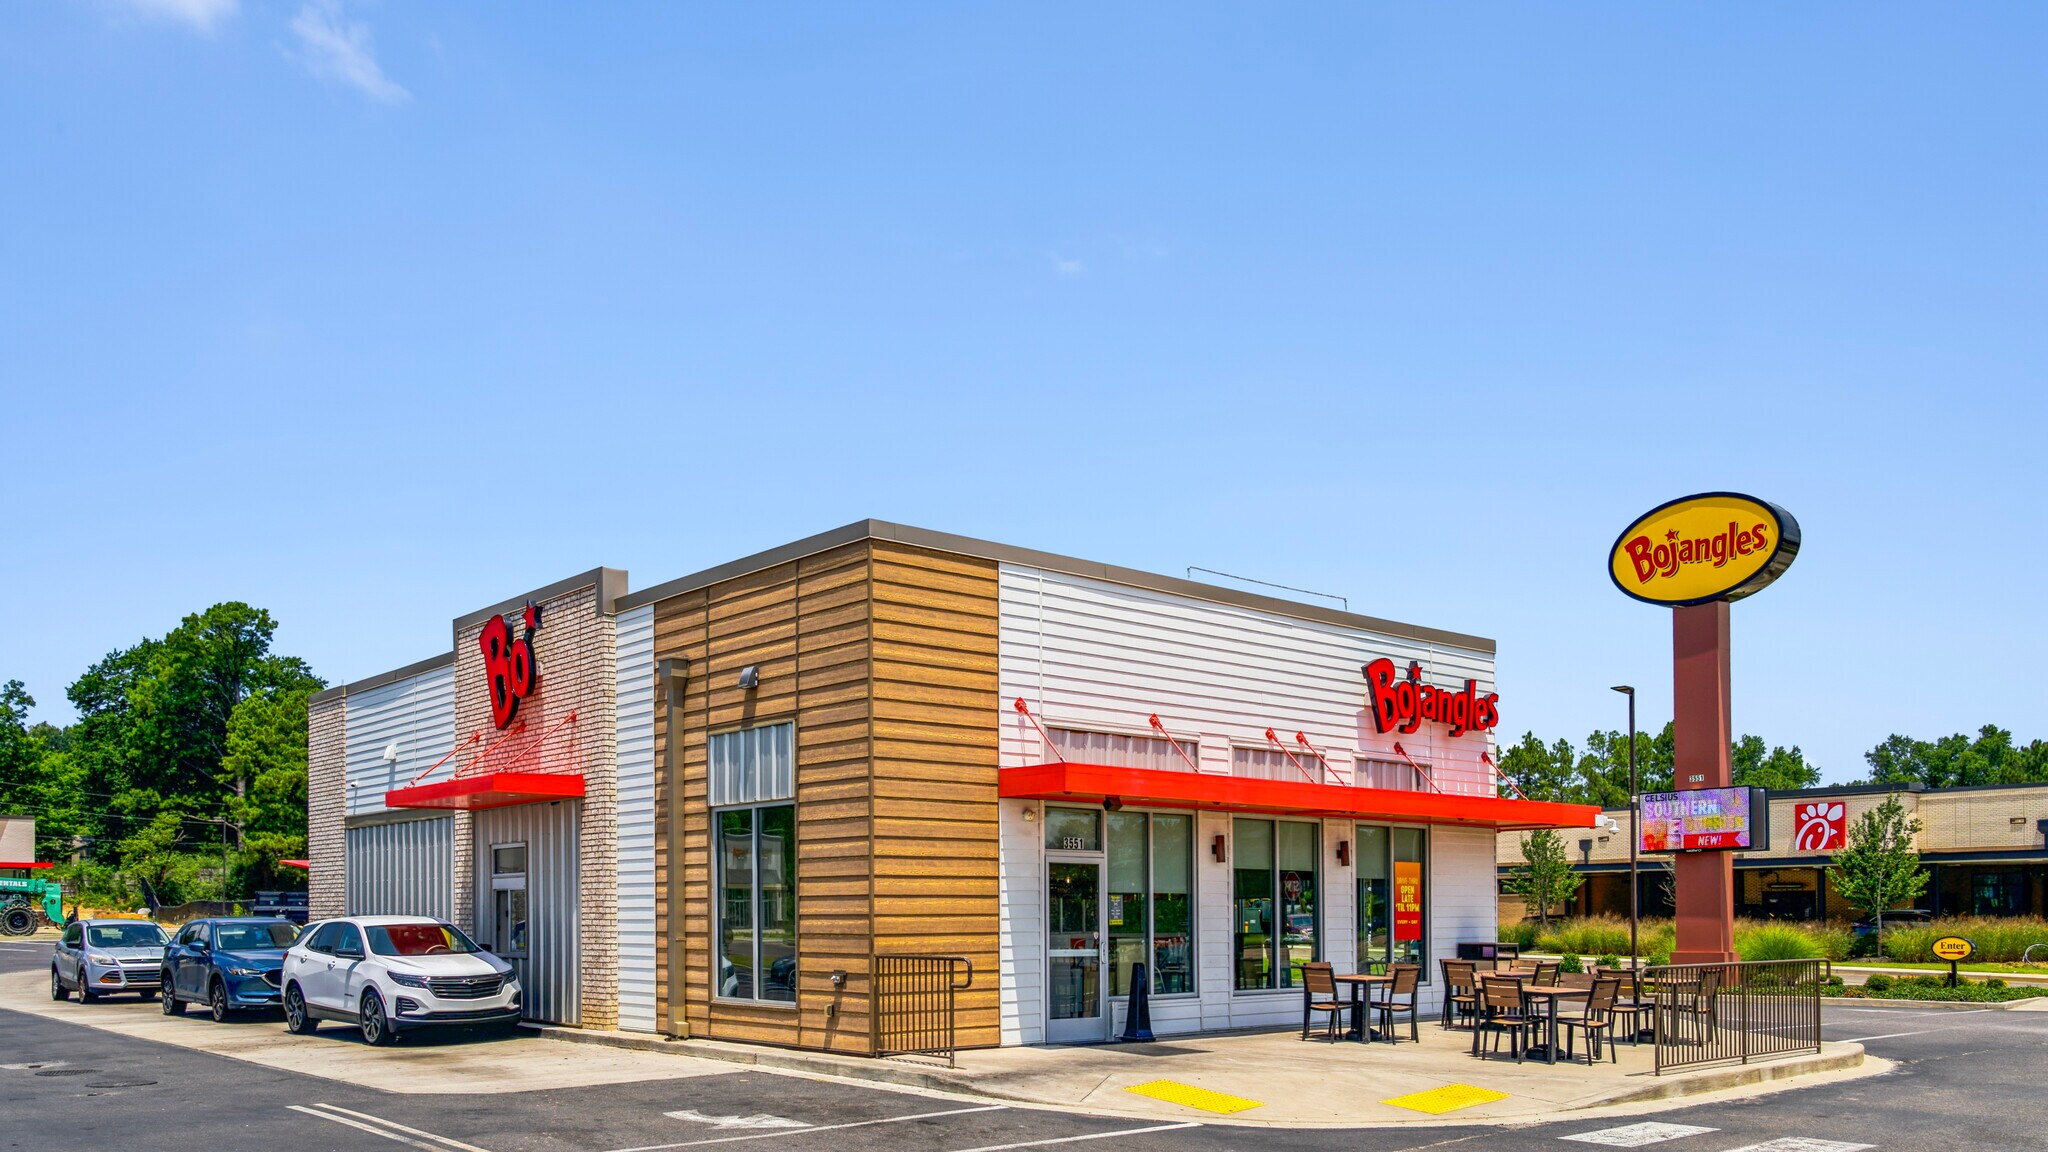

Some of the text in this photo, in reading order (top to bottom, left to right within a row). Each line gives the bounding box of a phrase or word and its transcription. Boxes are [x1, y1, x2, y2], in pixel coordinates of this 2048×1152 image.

[1624, 521, 1768, 584] Bojangles
[1361, 658, 1499, 737] Bojangles
[1644, 793, 1678, 803] CELSIUS
[1645, 799, 1718, 818] SOUTHERN
[1064, 837, 1084, 849] 3551
[1697, 835, 1722, 846] NEW!
[1400, 885, 1415, 894] OPEN
[1401, 894, 1414, 903] LATE
[1940, 942, 1965, 950] Enter
